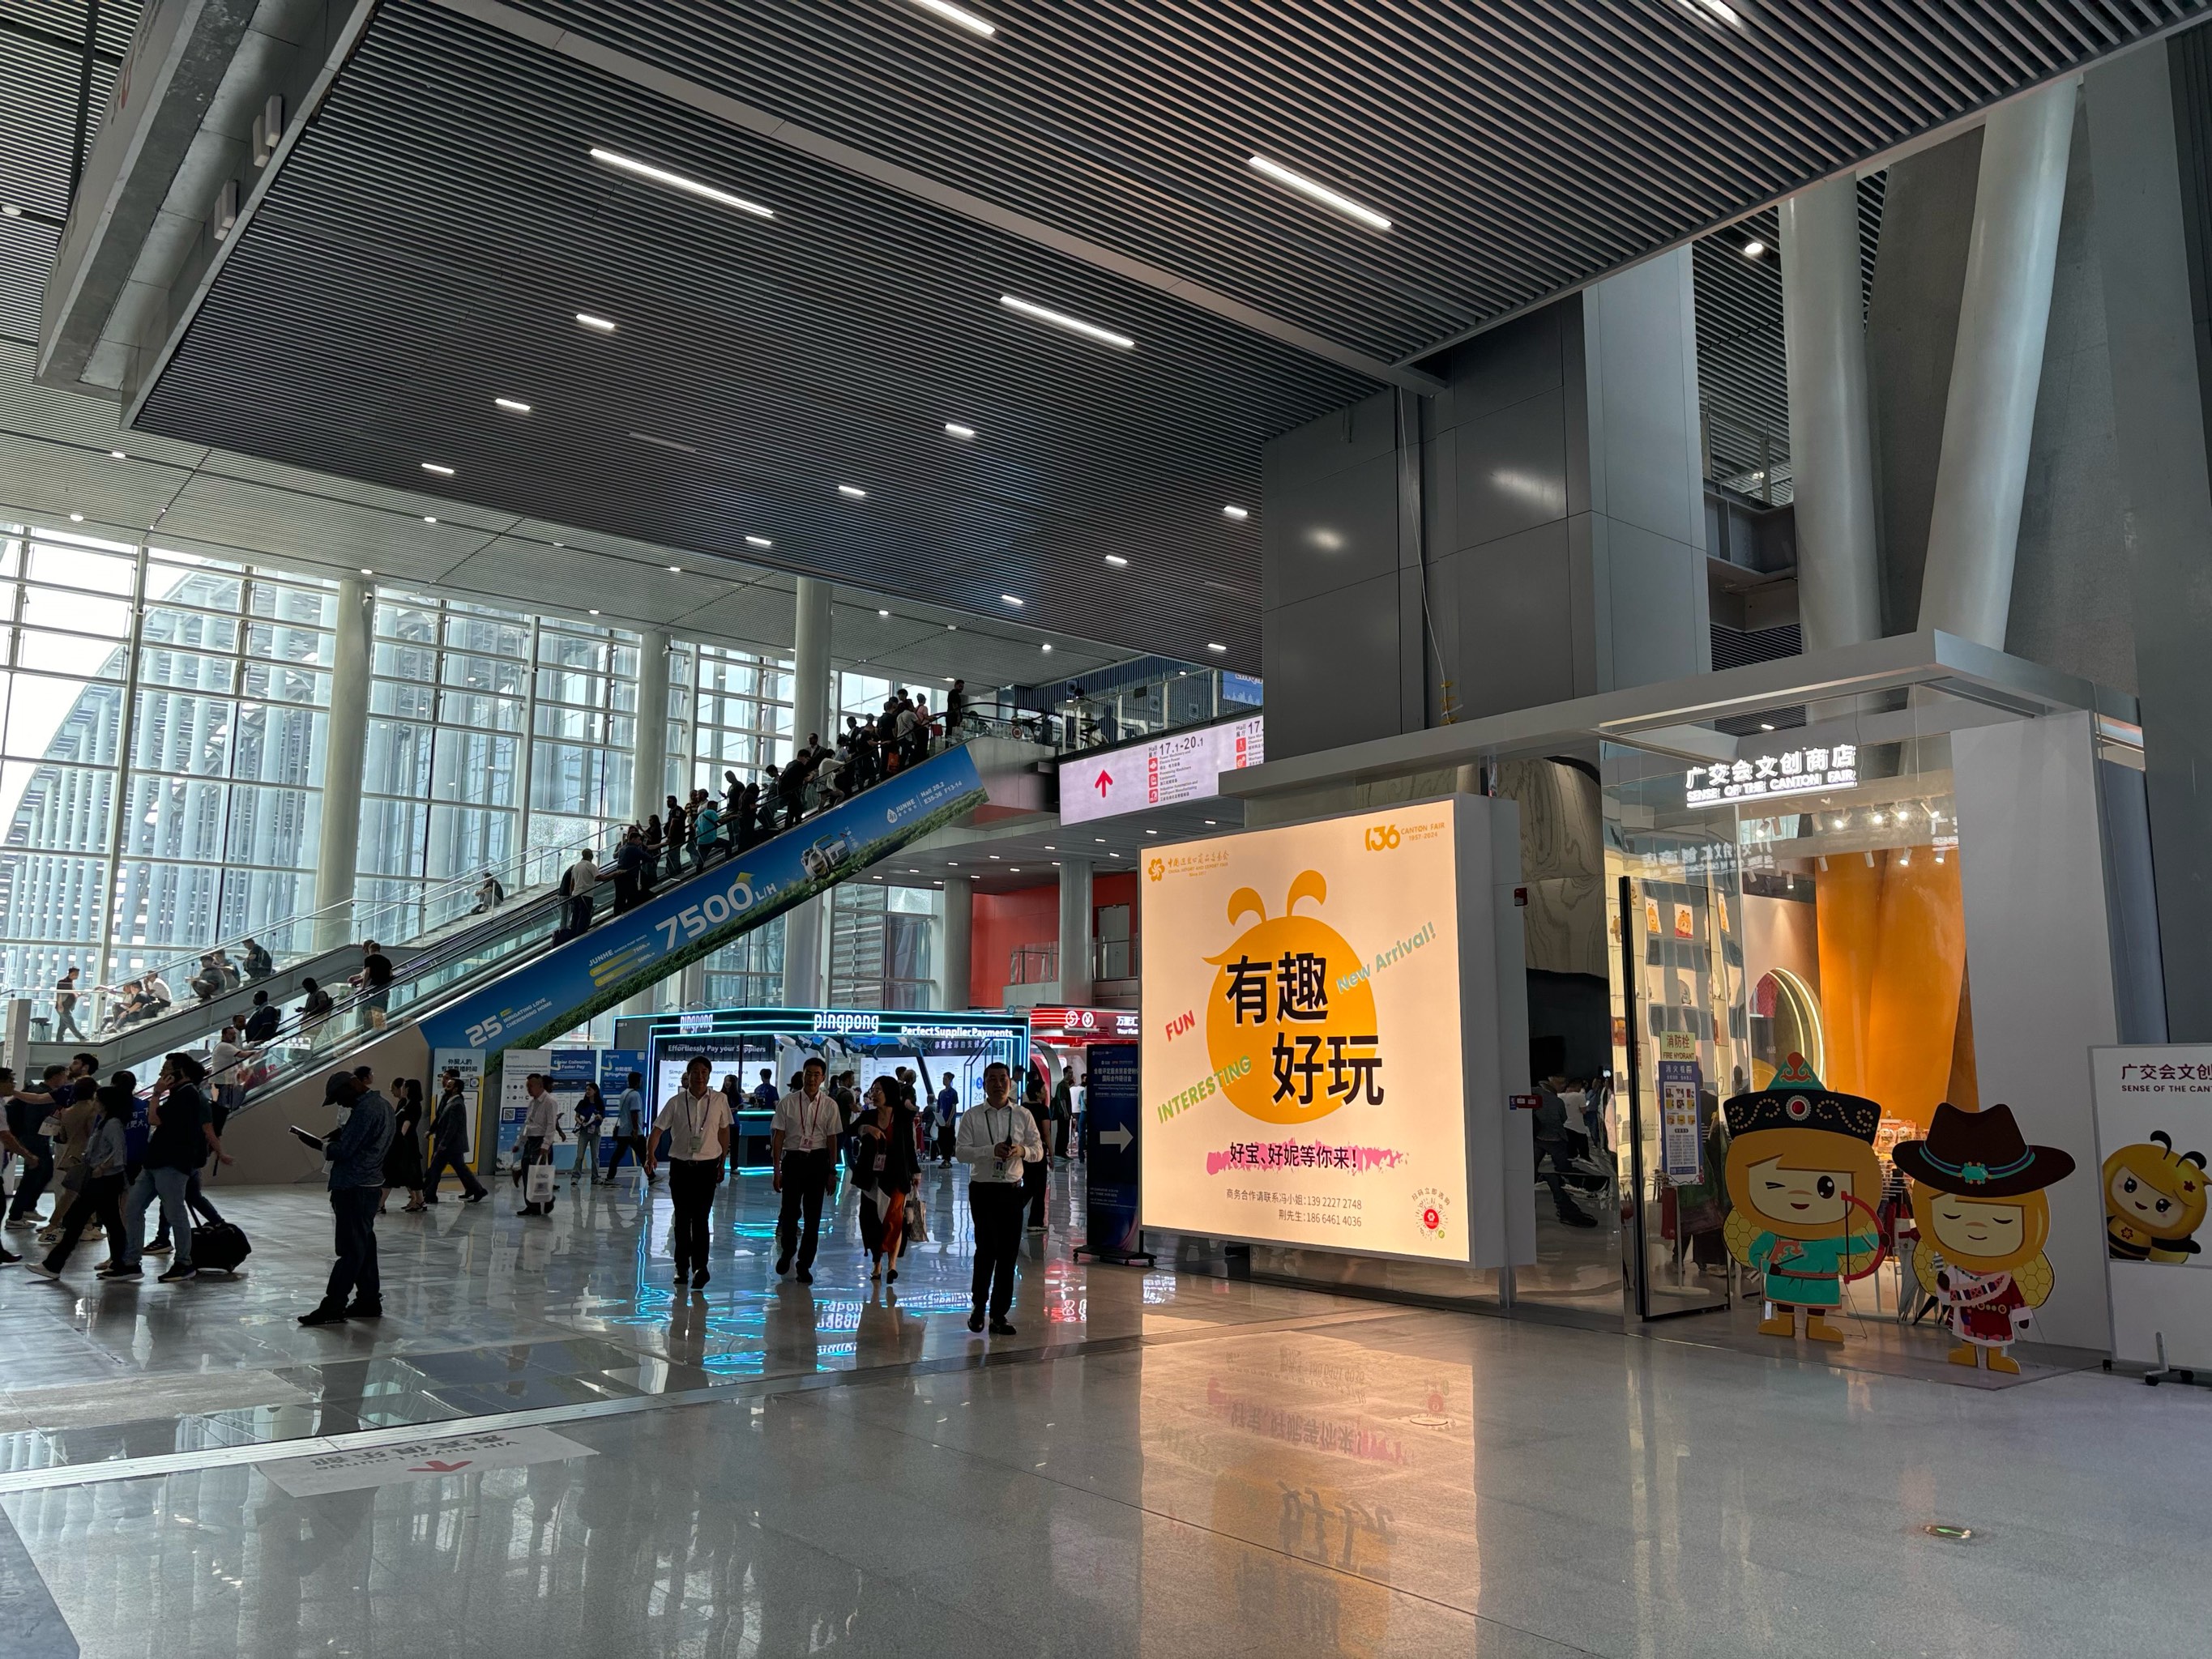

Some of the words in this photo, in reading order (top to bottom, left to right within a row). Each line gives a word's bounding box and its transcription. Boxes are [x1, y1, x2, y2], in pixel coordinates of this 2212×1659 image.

[1159, 736, 1203, 755] 17.1-20.1
[1686, 744, 1856, 789] 广交会文创商店
[920, 787, 932, 798] Hall
[1687, 787, 1720, 802] SENSE
[1724, 784, 1741, 797] OF
[1743, 781, 1766, 795] THE
[1770, 774, 1821, 791] CANTON
[1827, 769, 1856, 784] FAIR
[895, 798, 916, 812] JUNHE
[1365, 824, 1400, 851] 136
[1401, 825, 1428, 835] CANTON
[1430, 822, 1445, 830] FAIR
[655, 882, 754, 951] 7500
[754, 882, 778, 902] L/H
[588, 949, 614, 966] JUNHE
[1335, 963, 1371, 994] New
[1375, 922, 1437, 973] Arrival!
[1225, 950, 1329, 1026] 有趣
[503, 1004, 532, 1023] IRRIGATING
[532, 997, 546, 1008] LOVE
[506, 1009, 537, 1029] CHERISHING
[537, 1000, 553, 1012] HOME
[465, 1015, 502, 1047] 25
[680, 1013, 713, 1034] pingpong
[813, 1012, 879, 1034] pingpong
[901, 1026, 933, 1036] Perfect
[934, 1026, 972, 1038] Supplier
[973, 1028, 1013, 1038] Payments
[1164, 1010, 1196, 1042] FUN
[668, 1045, 706, 1053] Effortlessly
[707, 1045, 718, 1053] Pay
[736, 1045, 767, 1053] Sppliers
[1667, 1034, 1690, 1049] 消防栓
[1271, 1031, 1385, 1107] 好玩
[2122, 1064, 2212, 1080] 广交会文创
[1156, 1055, 1252, 1124] INTERESTING
[1322, 1196, 1341, 1209] 2227
[1343, 1198, 1362, 1210] 2748
[1322, 1213, 1341, 1226] 6461
[1343, 1215, 1362, 1227] 4036
[413, 1446, 477, 1458] Buyer
[484, 1440, 521, 1448] VIP
[315, 1456, 405, 1471] Lounge
